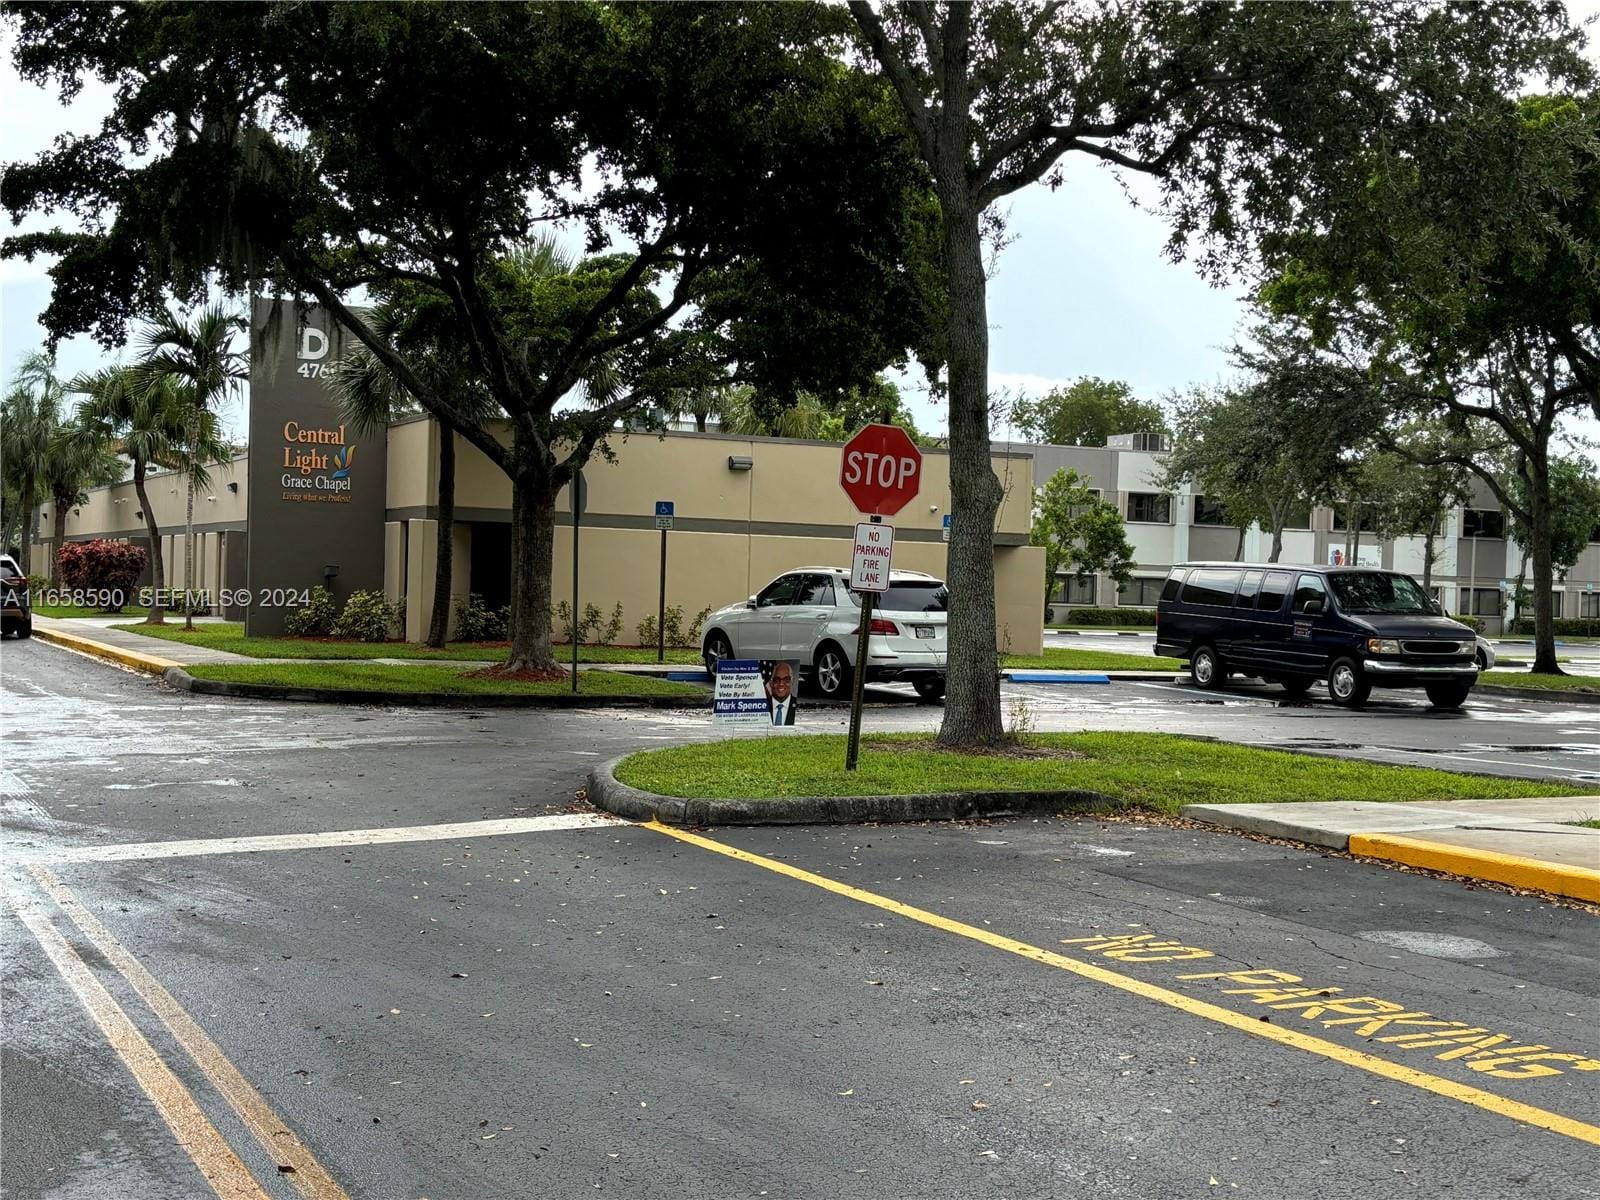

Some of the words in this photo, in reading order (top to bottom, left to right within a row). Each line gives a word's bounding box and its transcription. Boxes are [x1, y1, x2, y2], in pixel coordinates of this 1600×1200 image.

[297, 327, 330, 360] D
[283, 421, 346, 445] Central
[282, 447, 329, 475] Light
[845, 451, 917, 489] STOP
[281, 474, 313, 488] Grace
[315, 475, 351, 493] Chapel
[868, 531, 880, 543] NO
[855, 545, 890, 558] PARKING
[862, 559, 880, 570] FIRE
[860, 573, 880, 583] LANE
[716, 702, 736, 711] Mark
[737, 701, 768, 712] Spence
[1059, 931, 1216, 962] NO
[1176, 968, 1600, 1080] PARKING
